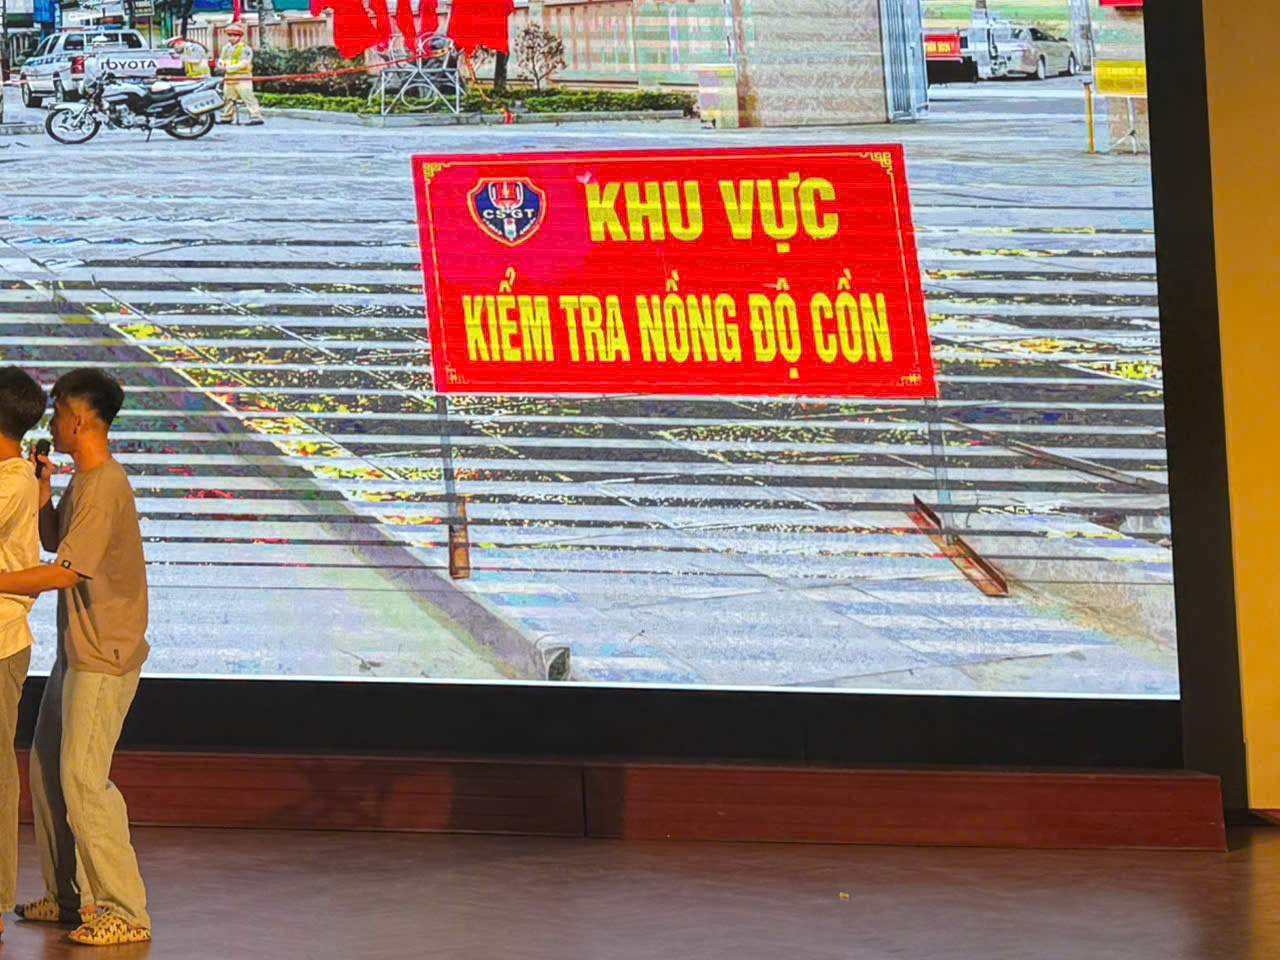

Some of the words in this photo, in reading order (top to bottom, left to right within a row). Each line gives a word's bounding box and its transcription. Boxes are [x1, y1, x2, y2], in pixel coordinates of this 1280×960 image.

[101, 58, 157, 70] TOYOTA
[482, 208, 535, 219] CSGT
[584, 180, 704, 242] KHU
[717, 171, 839, 254] VỰC
[461, 266, 555, 362] KIỂM
[559, 294, 631, 363] TRA
[635, 269, 742, 364] NỒNG
[747, 276, 802, 379] ĐỘ
[809, 267, 894, 364] CỒN
